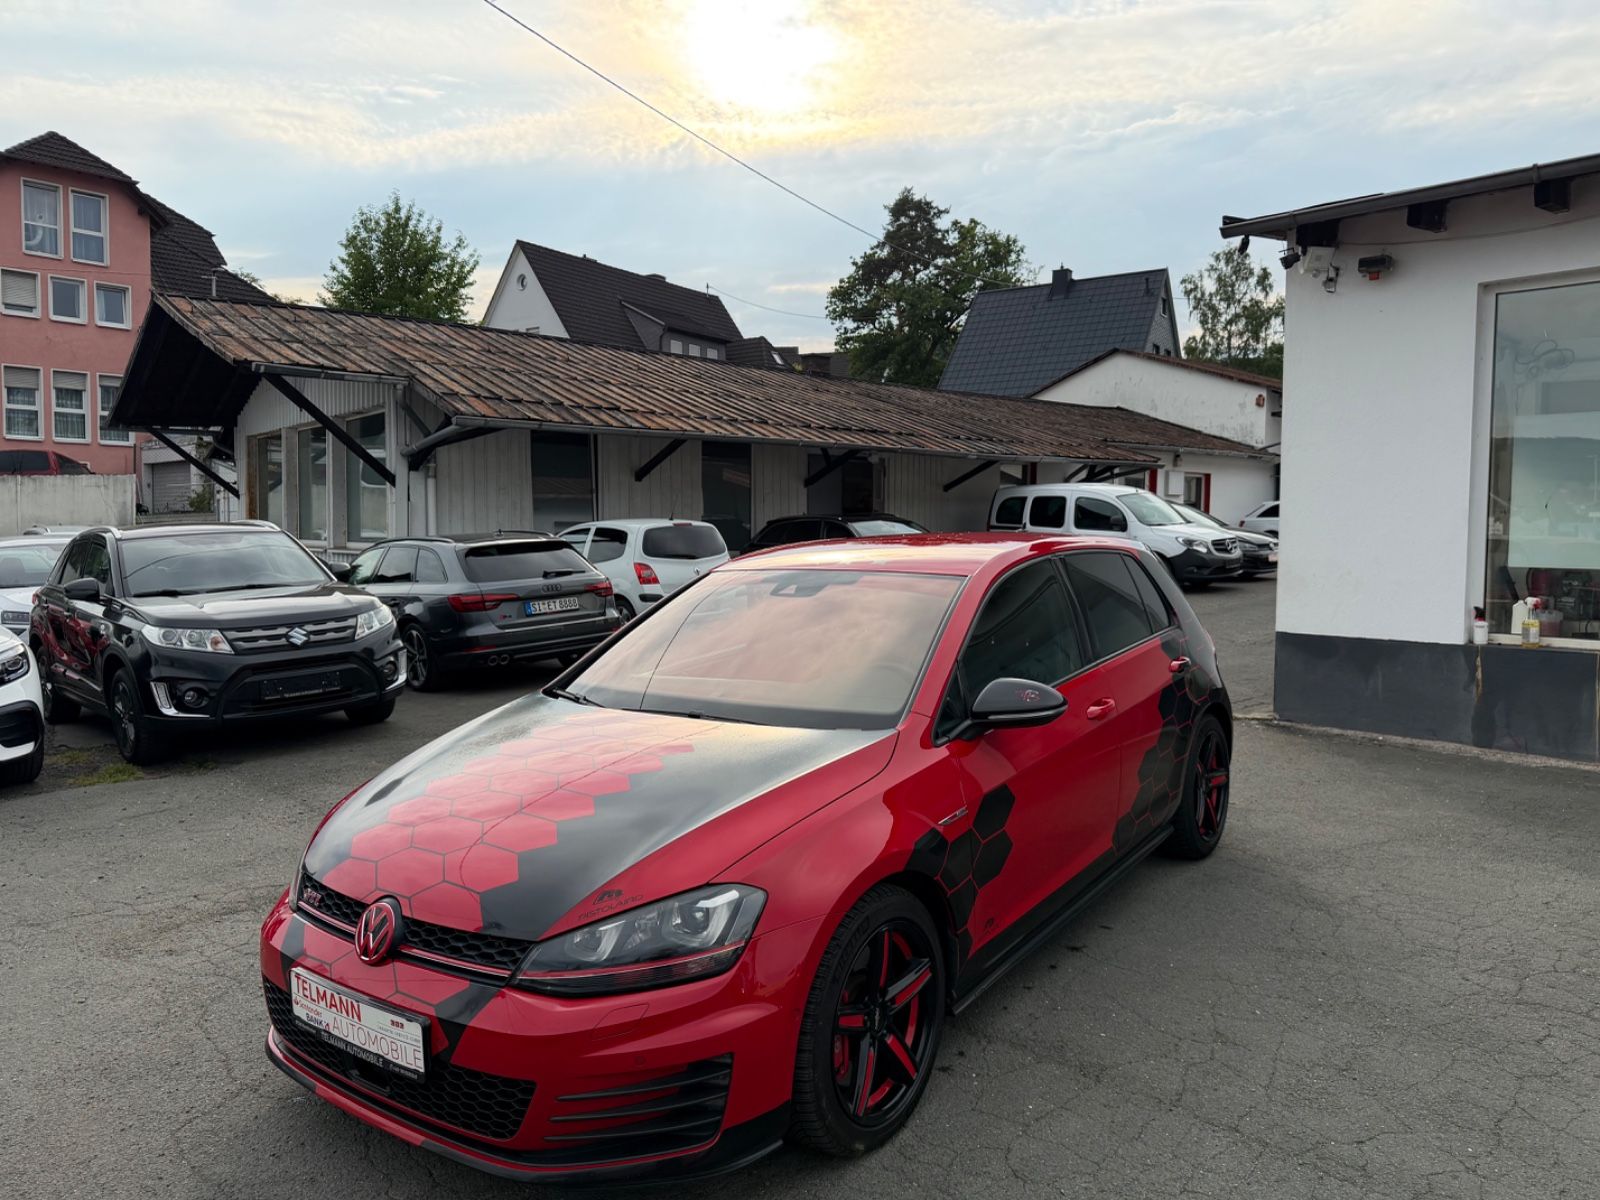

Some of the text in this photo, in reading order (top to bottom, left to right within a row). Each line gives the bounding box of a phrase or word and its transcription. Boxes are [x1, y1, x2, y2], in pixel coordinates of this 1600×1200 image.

[532, 602, 542, 613] SI
[547, 600, 558, 611] ET
[294, 974, 362, 1023] TELMANN
[332, 1017, 423, 1070] AUTOMOBILE
[345, 1044, 384, 1067] AUTOMOBILE
